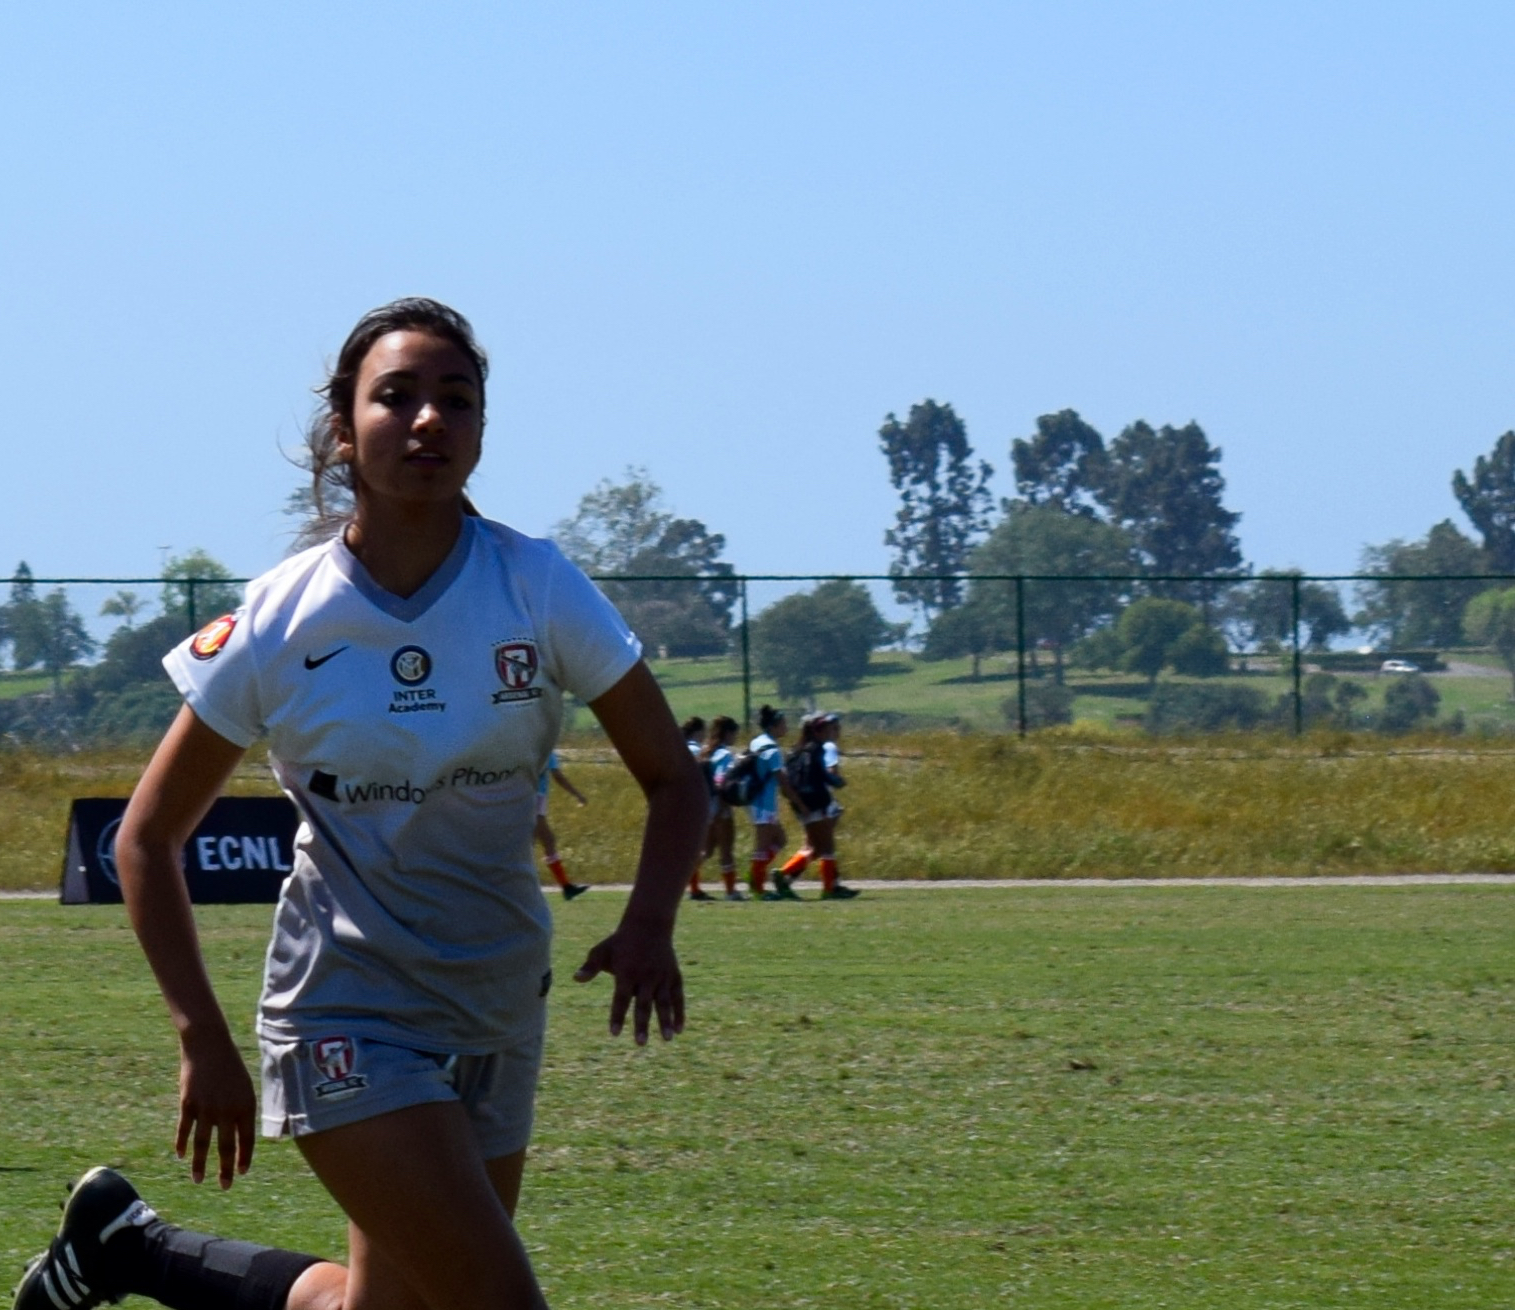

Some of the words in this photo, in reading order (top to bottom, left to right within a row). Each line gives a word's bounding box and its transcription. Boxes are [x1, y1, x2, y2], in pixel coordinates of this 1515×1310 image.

[388, 702, 446, 713] Academy
[393, 688, 437, 702] INTER
[345, 776, 446, 804] Windos
[451, 764, 522, 787] Phon
[196, 835, 292, 871] ECNL
